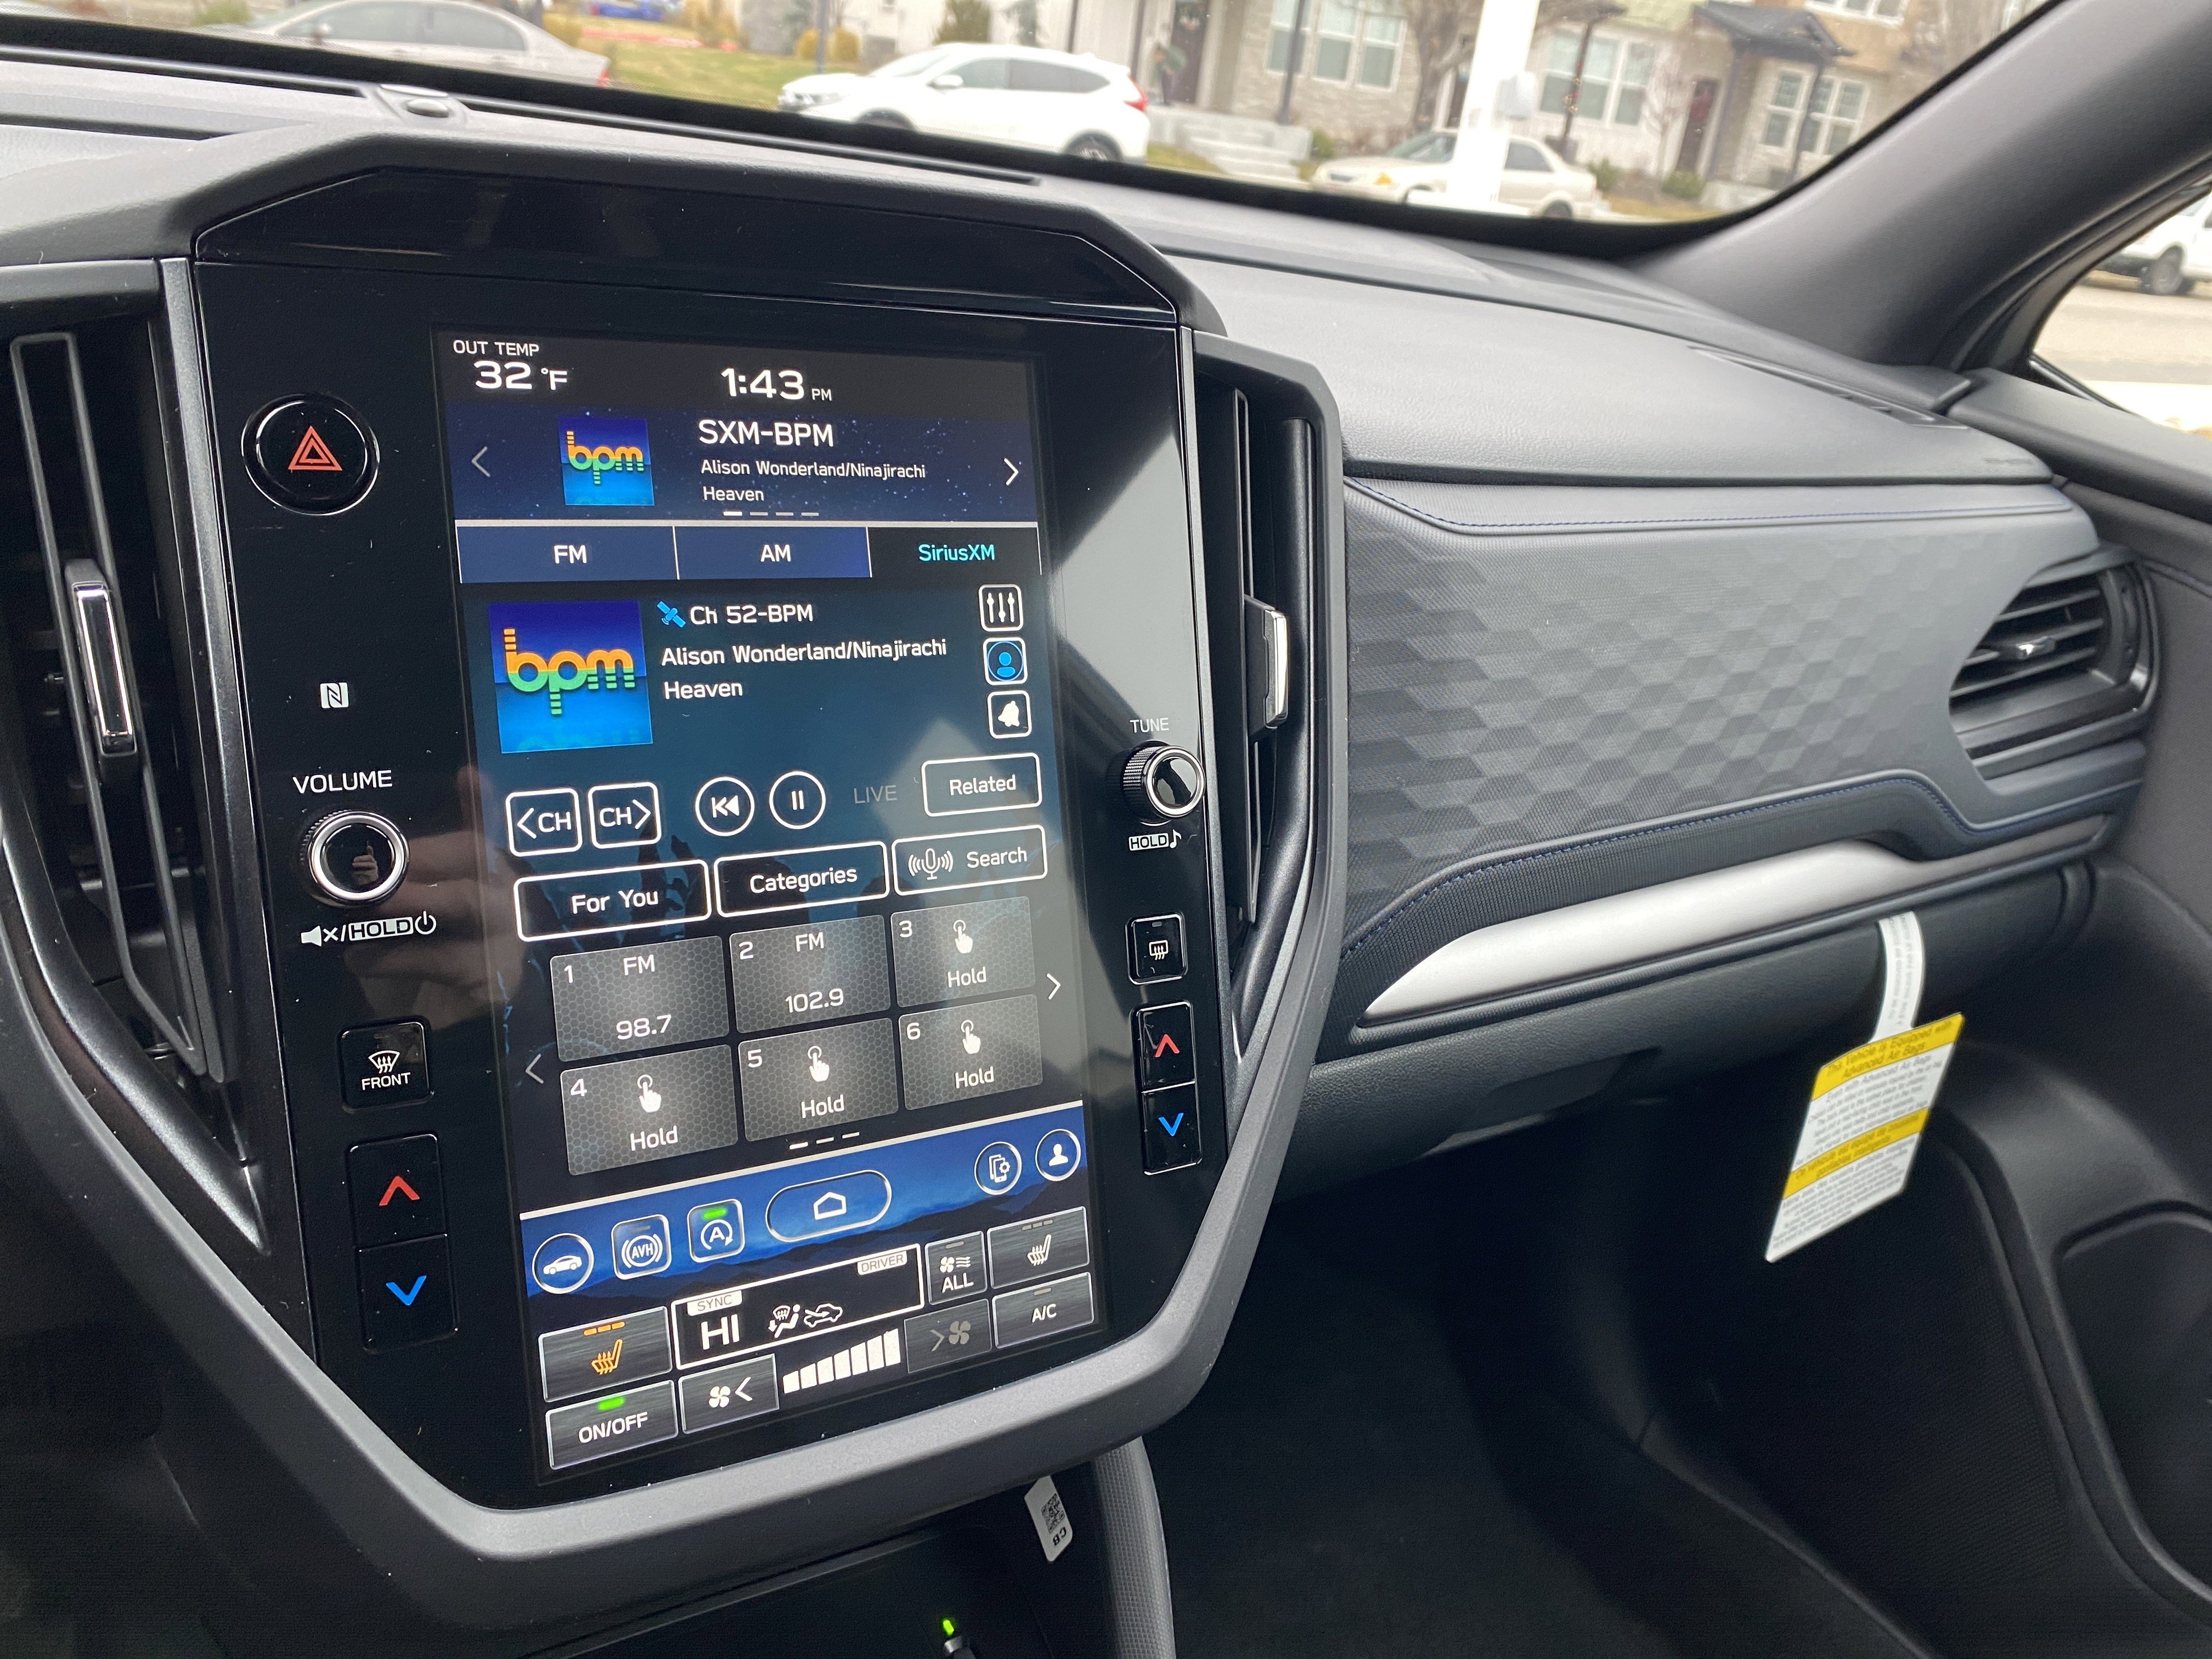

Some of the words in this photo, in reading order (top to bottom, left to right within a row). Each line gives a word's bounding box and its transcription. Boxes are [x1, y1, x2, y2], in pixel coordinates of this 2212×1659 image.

[453, 340, 489, 354] OUT
[494, 341, 539, 357] TEMP
[473, 360, 532, 390] 32
[721, 368, 804, 400] 1:43
[811, 388, 832, 401] PM
[698, 419, 833, 447] SXM-BPM
[567, 431, 644, 484] bpm
[701, 459, 751, 475] Alison
[755, 460, 926, 481] Wonderland/Ninajirachi
[703, 486, 764, 501] Heaven
[554, 545, 587, 564] FM
[760, 544, 791, 562] AM
[918, 544, 995, 561] SiriusXM
[690, 606, 718, 625] Ch
[726, 604, 813, 624] 52-BPM
[661, 647, 725, 666] Alison
[732, 638, 946, 663] Wonderland/Ninajirachi
[504, 629, 635, 715] bpm
[664, 681, 743, 699] Heaven
[1129, 717, 1170, 733] TUNE
[292, 770, 393, 794] VOLUME
[949, 774, 1016, 796] Related
[854, 785, 898, 804] LIVE
[1130, 834, 1167, 849] HOLD
[966, 847, 1028, 868] Search
[750, 867, 857, 894] Categories
[572, 894, 611, 915] For
[618, 889, 658, 908] You
[899, 920, 913, 938] 3
[738, 941, 754, 960] 2
[795, 932, 825, 952] FM
[563, 965, 573, 984] 1
[623, 954, 655, 976] FM
[947, 966, 987, 988] Hold
[785, 988, 844, 1013] 102.9
[616, 1014, 672, 1040] 98.7
[906, 1022, 921, 1040] 6
[747, 1048, 763, 1068] 5
[362, 1072, 411, 1091] FRONT
[955, 1065, 995, 1089] Hold
[570, 1078, 588, 1097] 4
[801, 1094, 845, 1119] Hold
[630, 1125, 678, 1152] Hold
[631, 1243, 653, 1260] AVH
[861, 1254, 904, 1273] DRIVER
[942, 1273, 974, 1293] ALL
[697, 1294, 732, 1312] SYNC
[1032, 1304, 1057, 1323] A/C
[700, 1313, 740, 1350] HI
[578, 1412, 648, 1443] ON/OFF
